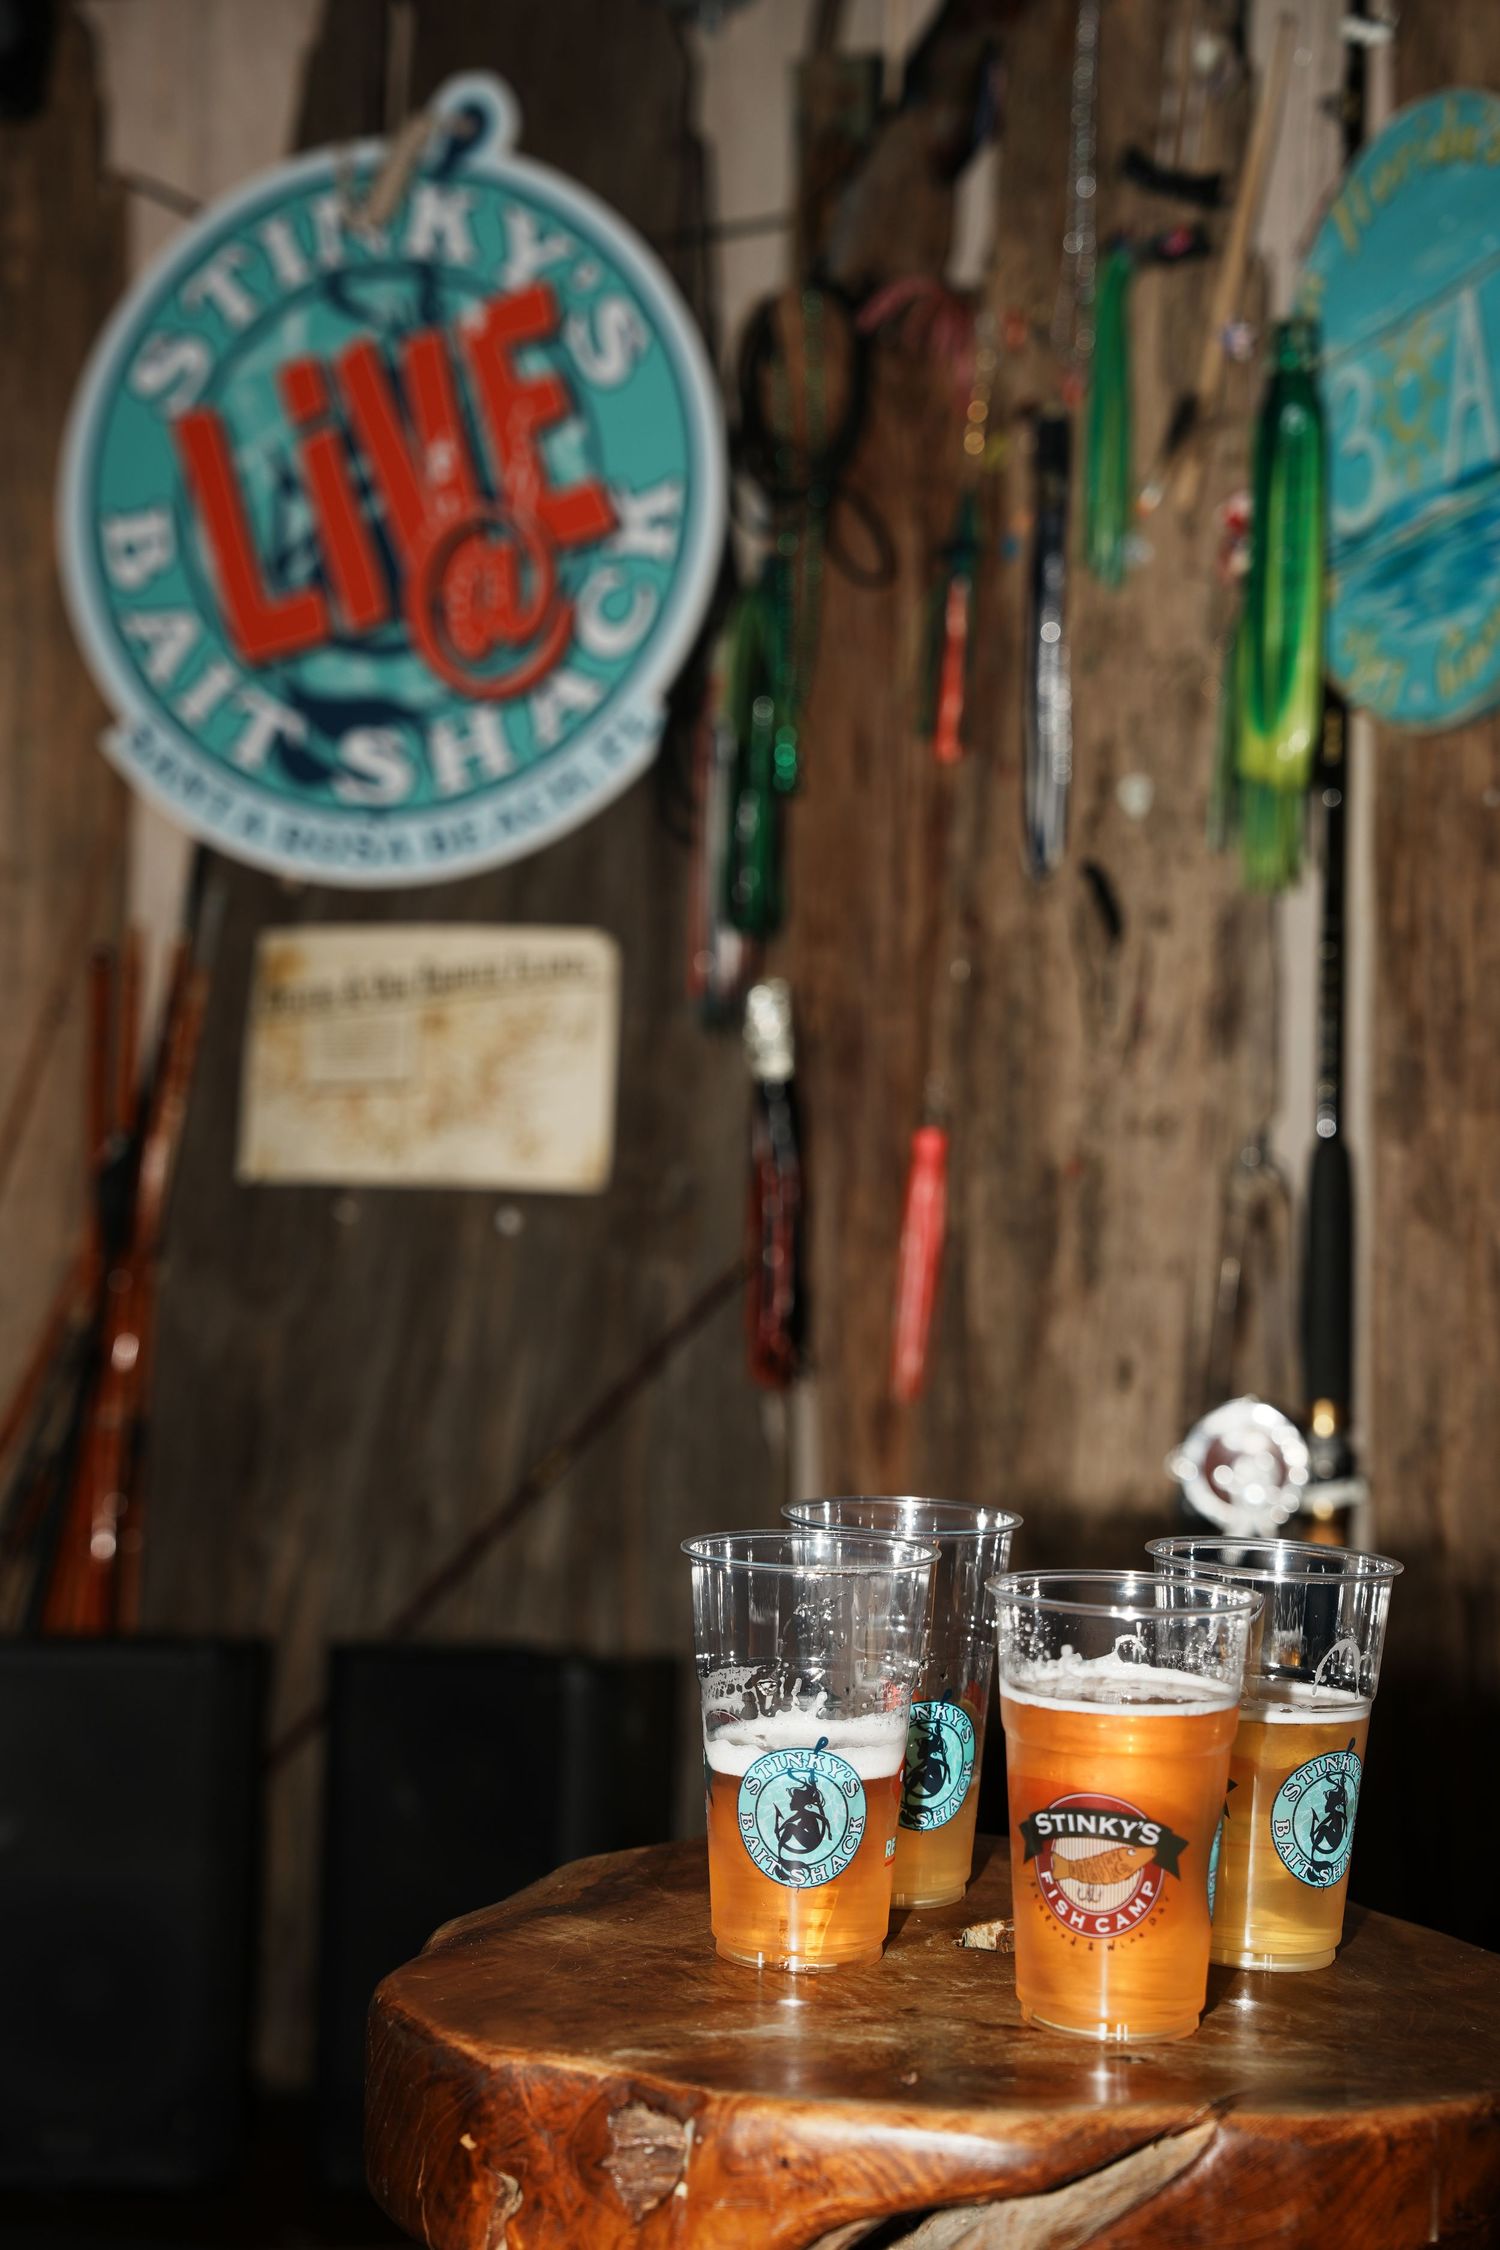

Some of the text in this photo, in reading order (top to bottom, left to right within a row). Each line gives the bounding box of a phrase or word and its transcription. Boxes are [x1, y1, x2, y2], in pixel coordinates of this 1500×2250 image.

[127, 185, 650, 414] STINKY'S
[100, 478, 684, 808] BAIT SHACK
[911, 1704, 973, 1745] NKY'S
[744, 1751, 861, 1798] STINKY'S
[913, 1759, 974, 1828] SHACK
[739, 1811, 865, 1886] BAIT SHACK
[1034, 1812, 1162, 1846] STINKY'S
[1273, 1818, 1314, 1879] BAIT
[1040, 1870, 1155, 1933] FISH CAMP
